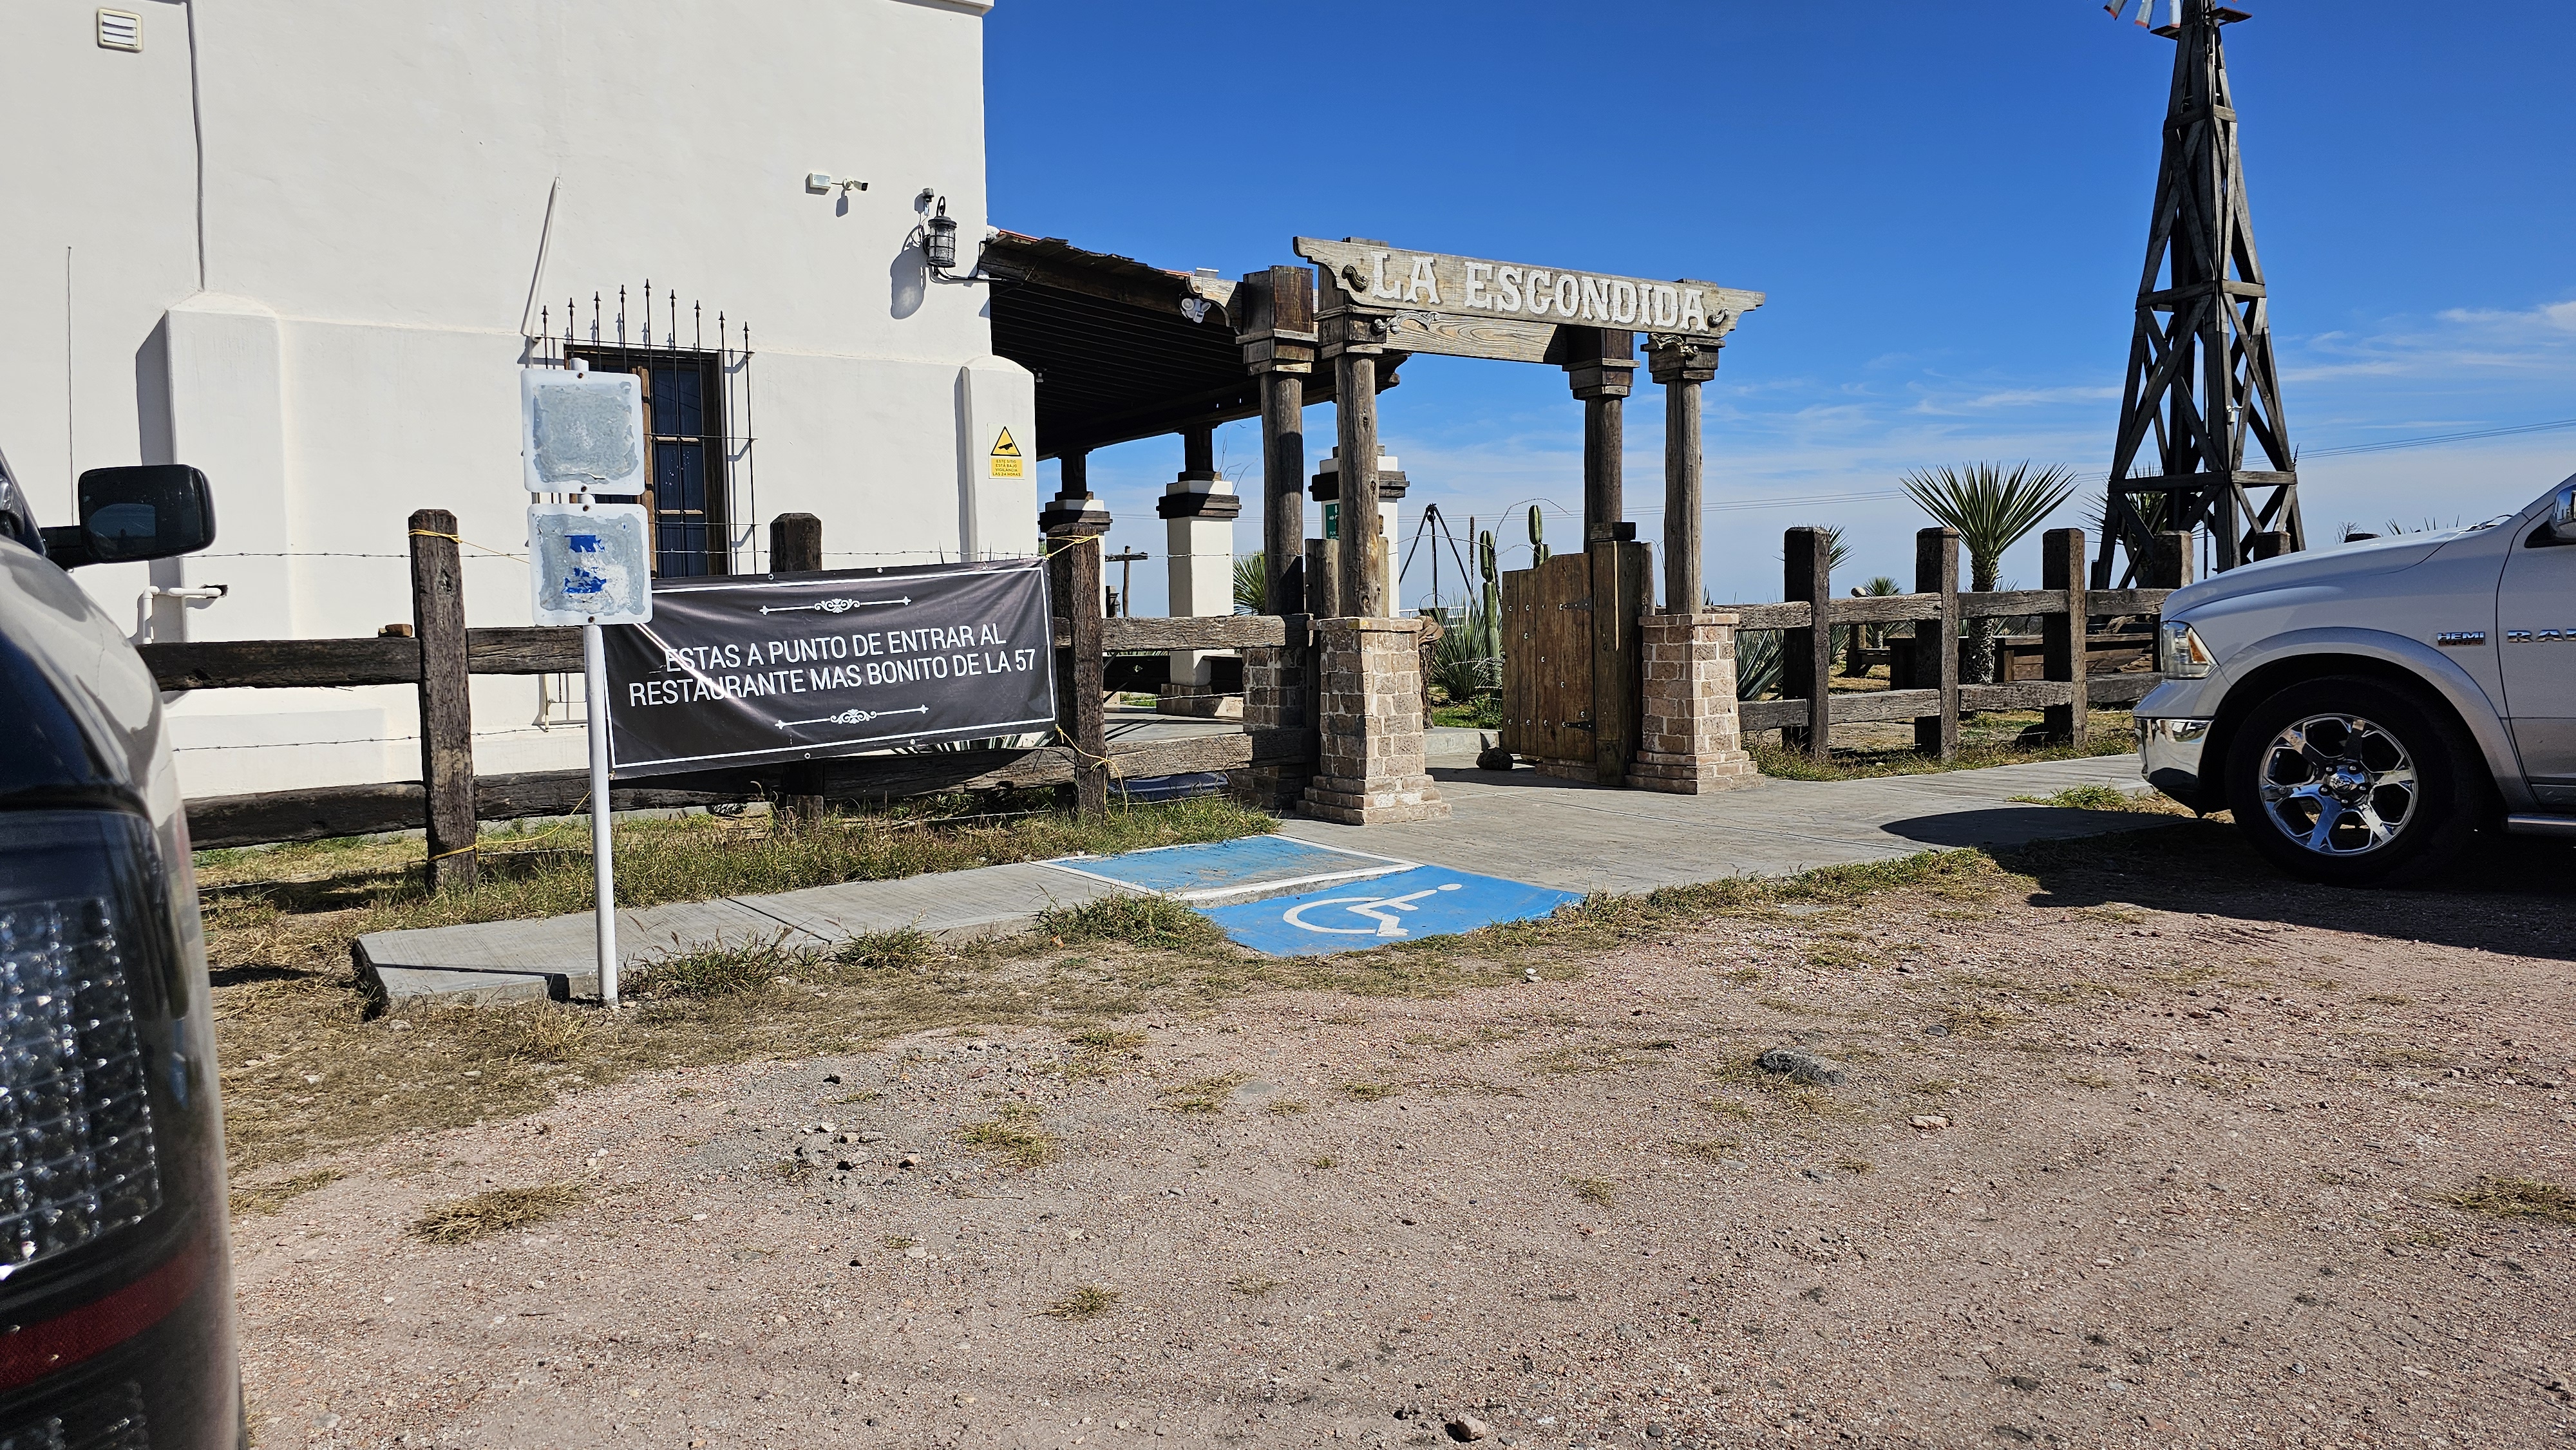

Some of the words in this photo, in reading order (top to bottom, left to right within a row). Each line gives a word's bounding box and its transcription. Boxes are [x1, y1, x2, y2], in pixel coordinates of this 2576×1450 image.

[1370, 250, 1442, 305] LA
[1463, 260, 1710, 332] ESCONDIDA
[665, 644, 741, 672] ESTAS
[747, 643, 764, 666] A
[768, 636, 847, 664] PUNTO
[852, 632, 884, 657] DE
[887, 625, 976, 654] ENTRAR
[980, 623, 1007, 646] AL
[2437, 632, 2485, 640] HEMI
[629, 669, 806, 707] RESTAURANTE
[810, 664, 862, 691] MAS
[866, 656, 948, 685] BONITO
[952, 653, 982, 677] DE
[985, 650, 1012, 673] LA
[1015, 648, 1036, 672] 57
